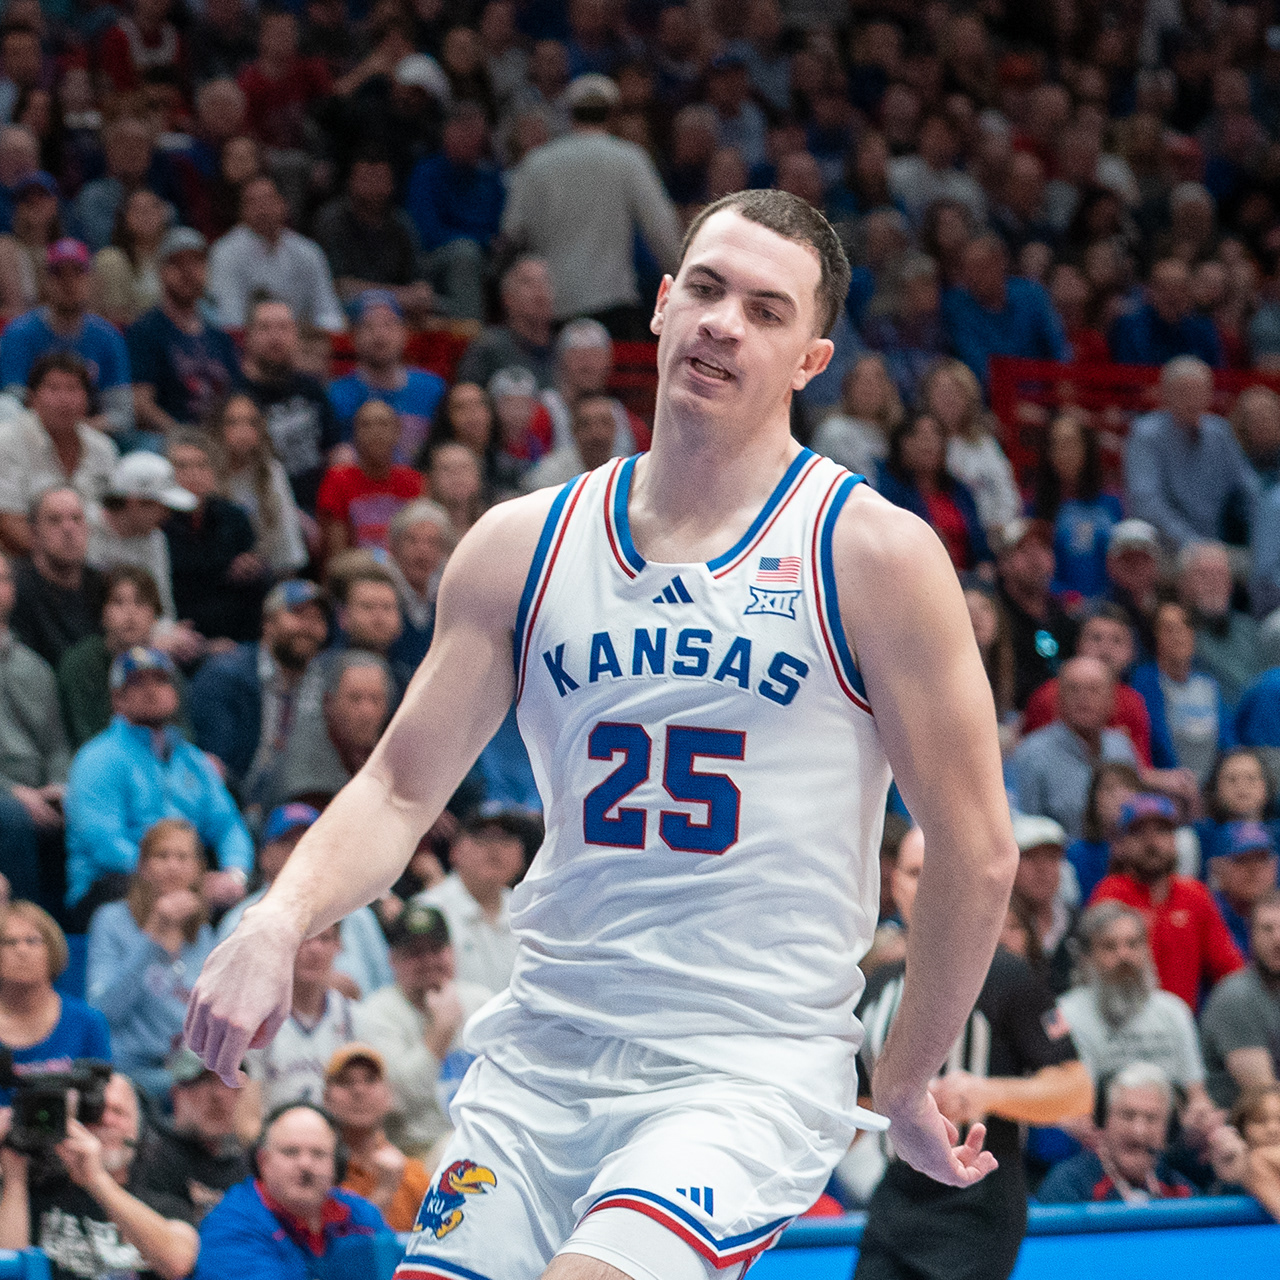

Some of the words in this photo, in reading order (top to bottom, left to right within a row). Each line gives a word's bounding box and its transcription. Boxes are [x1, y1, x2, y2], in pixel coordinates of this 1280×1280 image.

[543, 628, 810, 707] KANSAS
[583, 721, 747, 856] 25
[426, 1196, 445, 1215] KU
